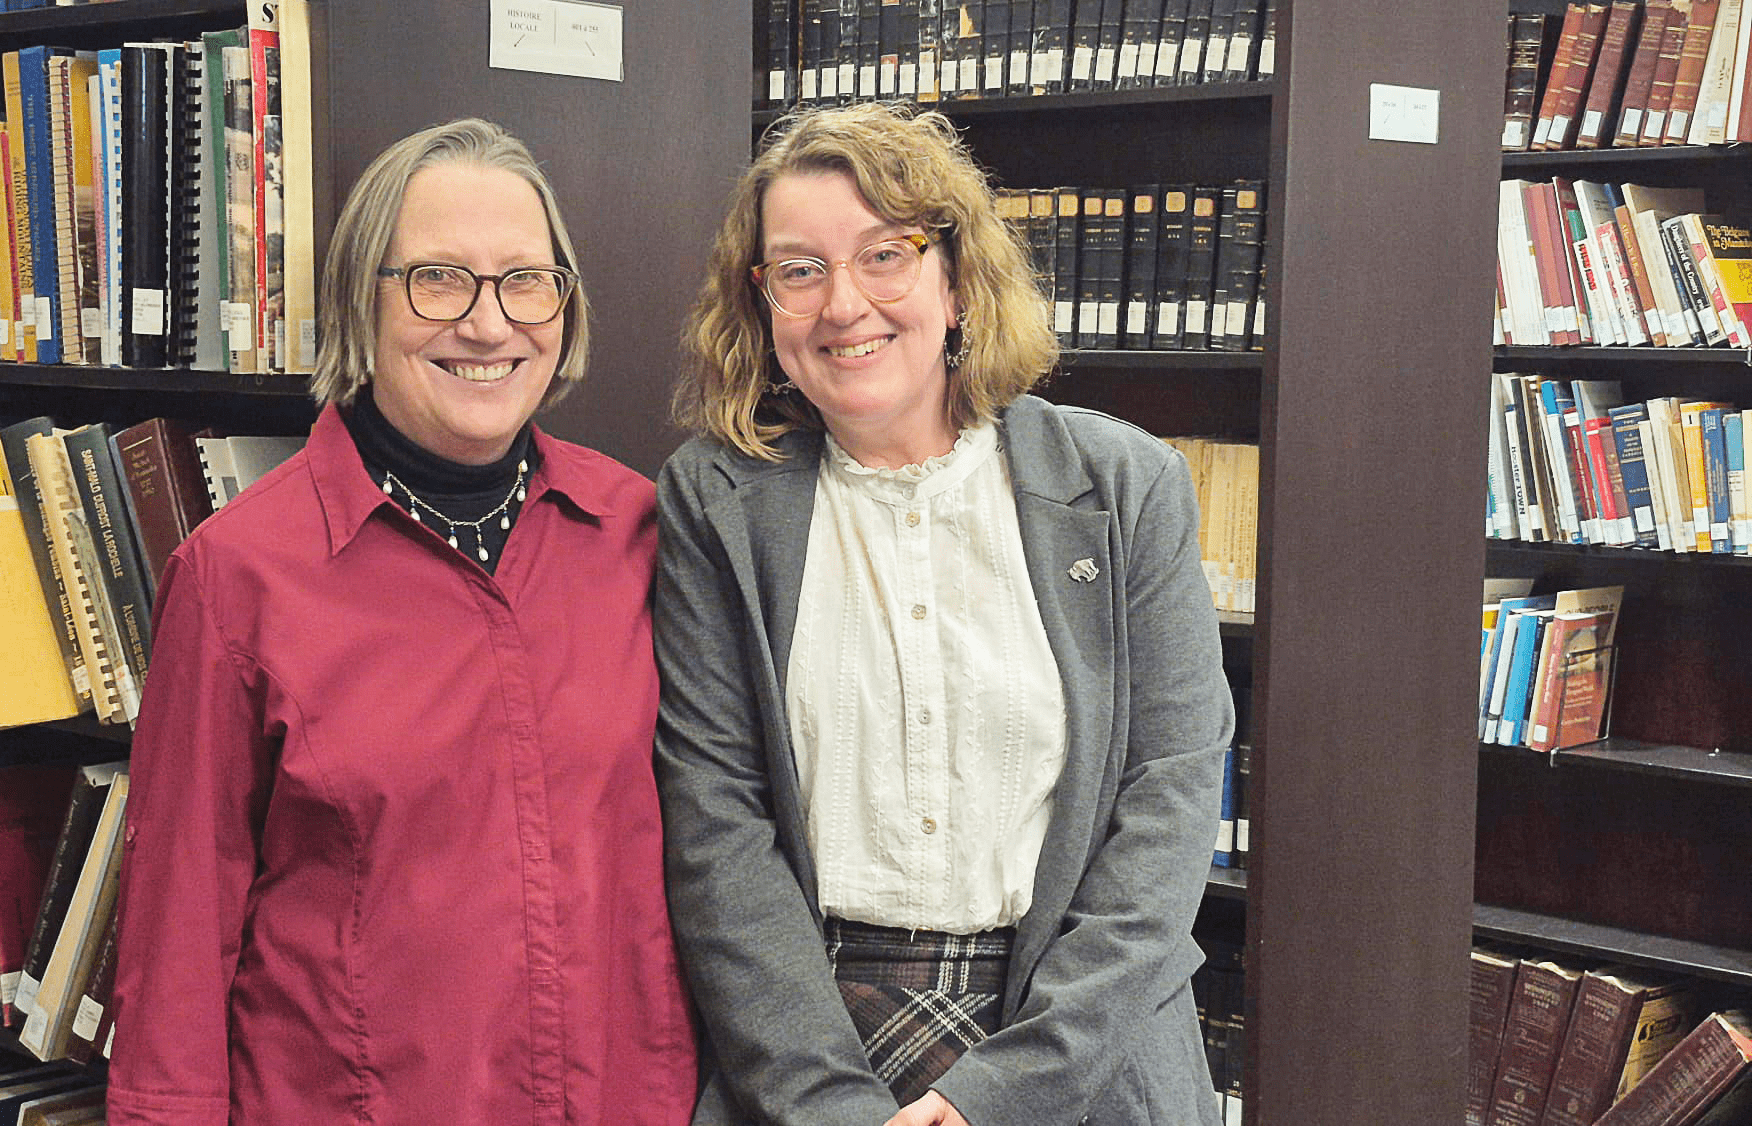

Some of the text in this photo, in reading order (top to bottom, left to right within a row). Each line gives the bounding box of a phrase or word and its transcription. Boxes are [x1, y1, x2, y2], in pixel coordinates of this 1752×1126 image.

[507, 9, 541, 20] HISTOIRE
[510, 22, 537, 32] LOCALE
[93, 493, 110, 529] DUFROST
[103, 529, 124, 579] LAROCHELLE
